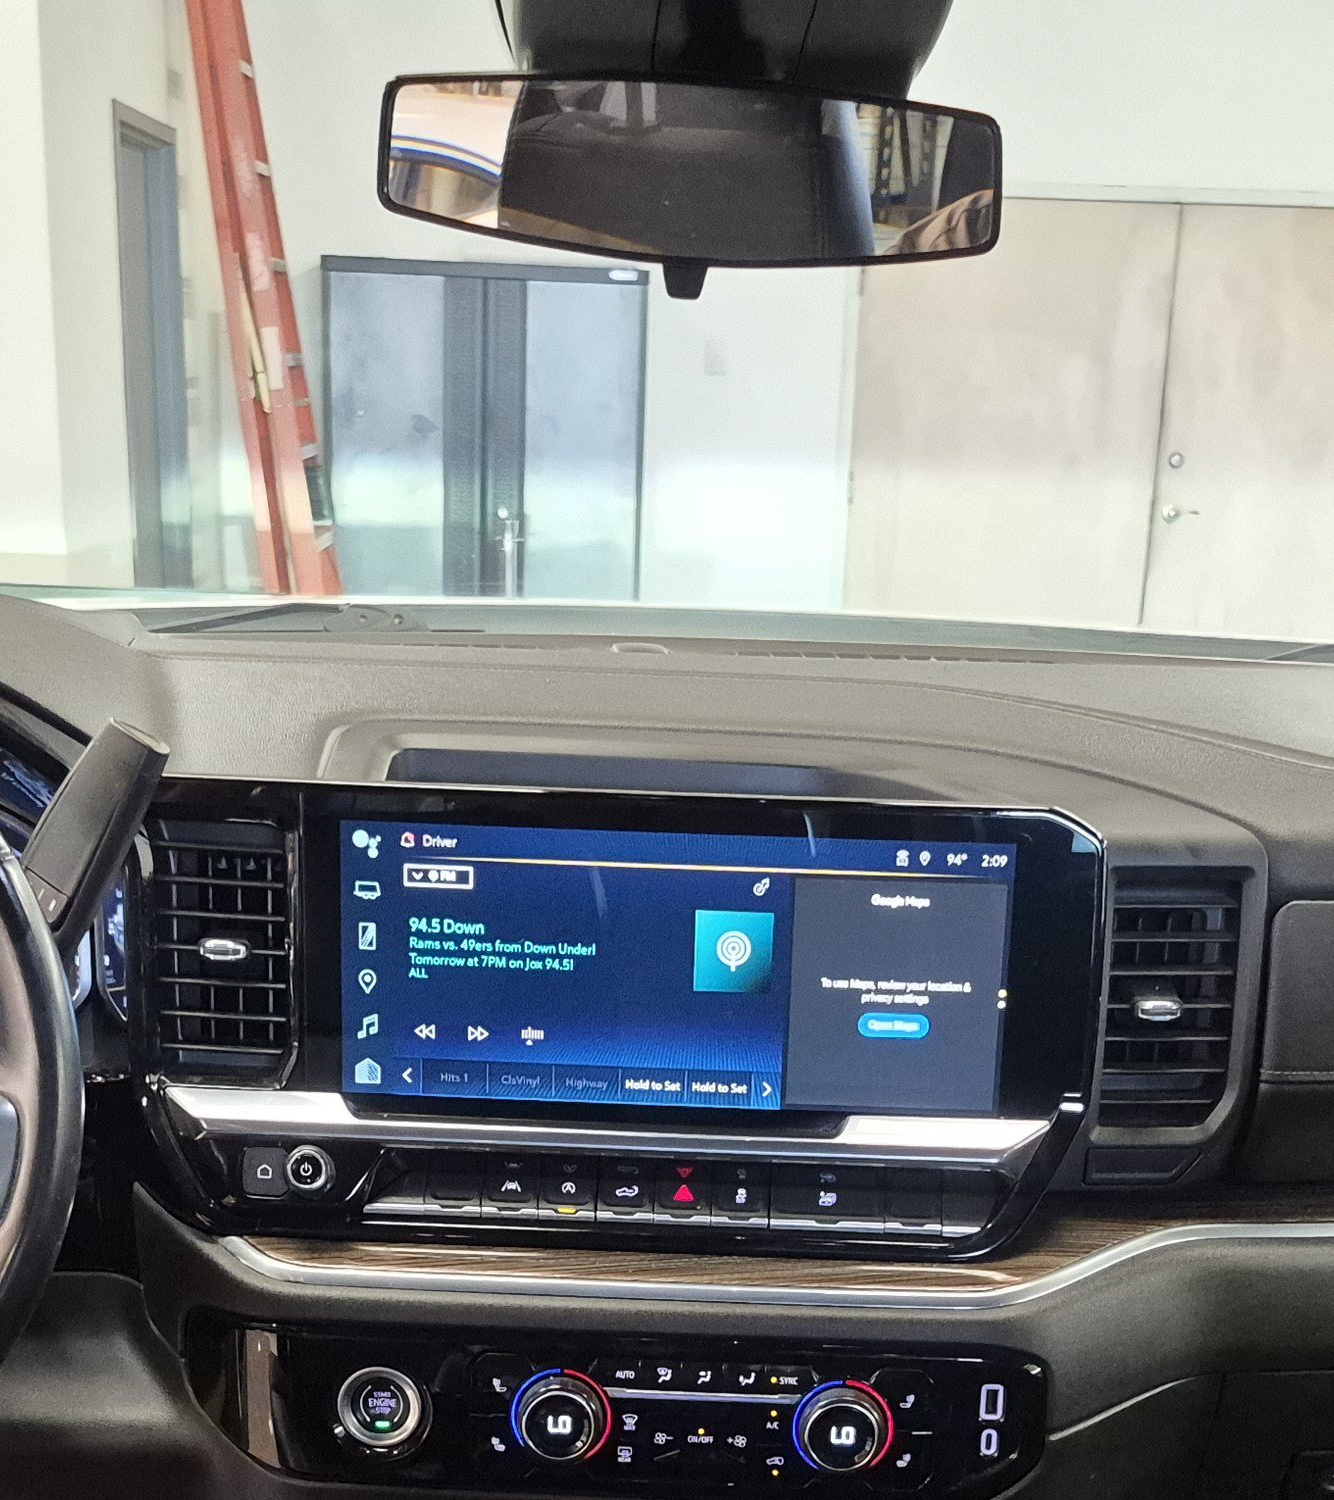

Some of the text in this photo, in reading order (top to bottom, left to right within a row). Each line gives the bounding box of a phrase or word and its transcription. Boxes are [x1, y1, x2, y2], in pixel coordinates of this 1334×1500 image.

[422, 834, 458, 848] Driver
[981, 854, 1008, 868] 2:09
[440, 870, 456, 882] FM
[871, 893, 931, 909] Google Maps
[409, 917, 485, 935] 94.5 Down
[409, 937, 441, 950] Rams
[443, 941, 458, 950] vs.
[460, 938, 493, 951] 49ers
[495, 939, 521, 953] from
[524, 941, 555, 954] Down
[409, 953, 465, 966] Tomorrow
[467, 956, 478, 967] at
[481, 955, 506, 968] 7PM
[509, 959, 523, 969] on
[525, 957, 543, 971] Jox
[409, 967, 428, 979] ALL
[821, 977, 832, 988] To
[832, 979, 849, 989] use
[906, 981, 927, 992] your
[928, 980, 962, 992] location
[963, 982, 972, 993] &
[861, 993, 893, 1004] privacy
[440, 1072, 460, 1083] Hits
[501, 1074, 540, 1086] ClsVinyl
[566, 1077, 609, 1091] Highway
[625, 1079, 681, 1092] Hold to Set
[691, 1081, 748, 1094] Hold to Set
[615, 1370, 635, 1379] AUTO
[779, 1376, 798, 1386] SYNC
[368, 1398, 397, 1408] ENGINE
[375, 1407, 392, 1415] STOP
[766, 1421, 779, 1430] A/C
[687, 1435, 714, 1445] ON/OFF
